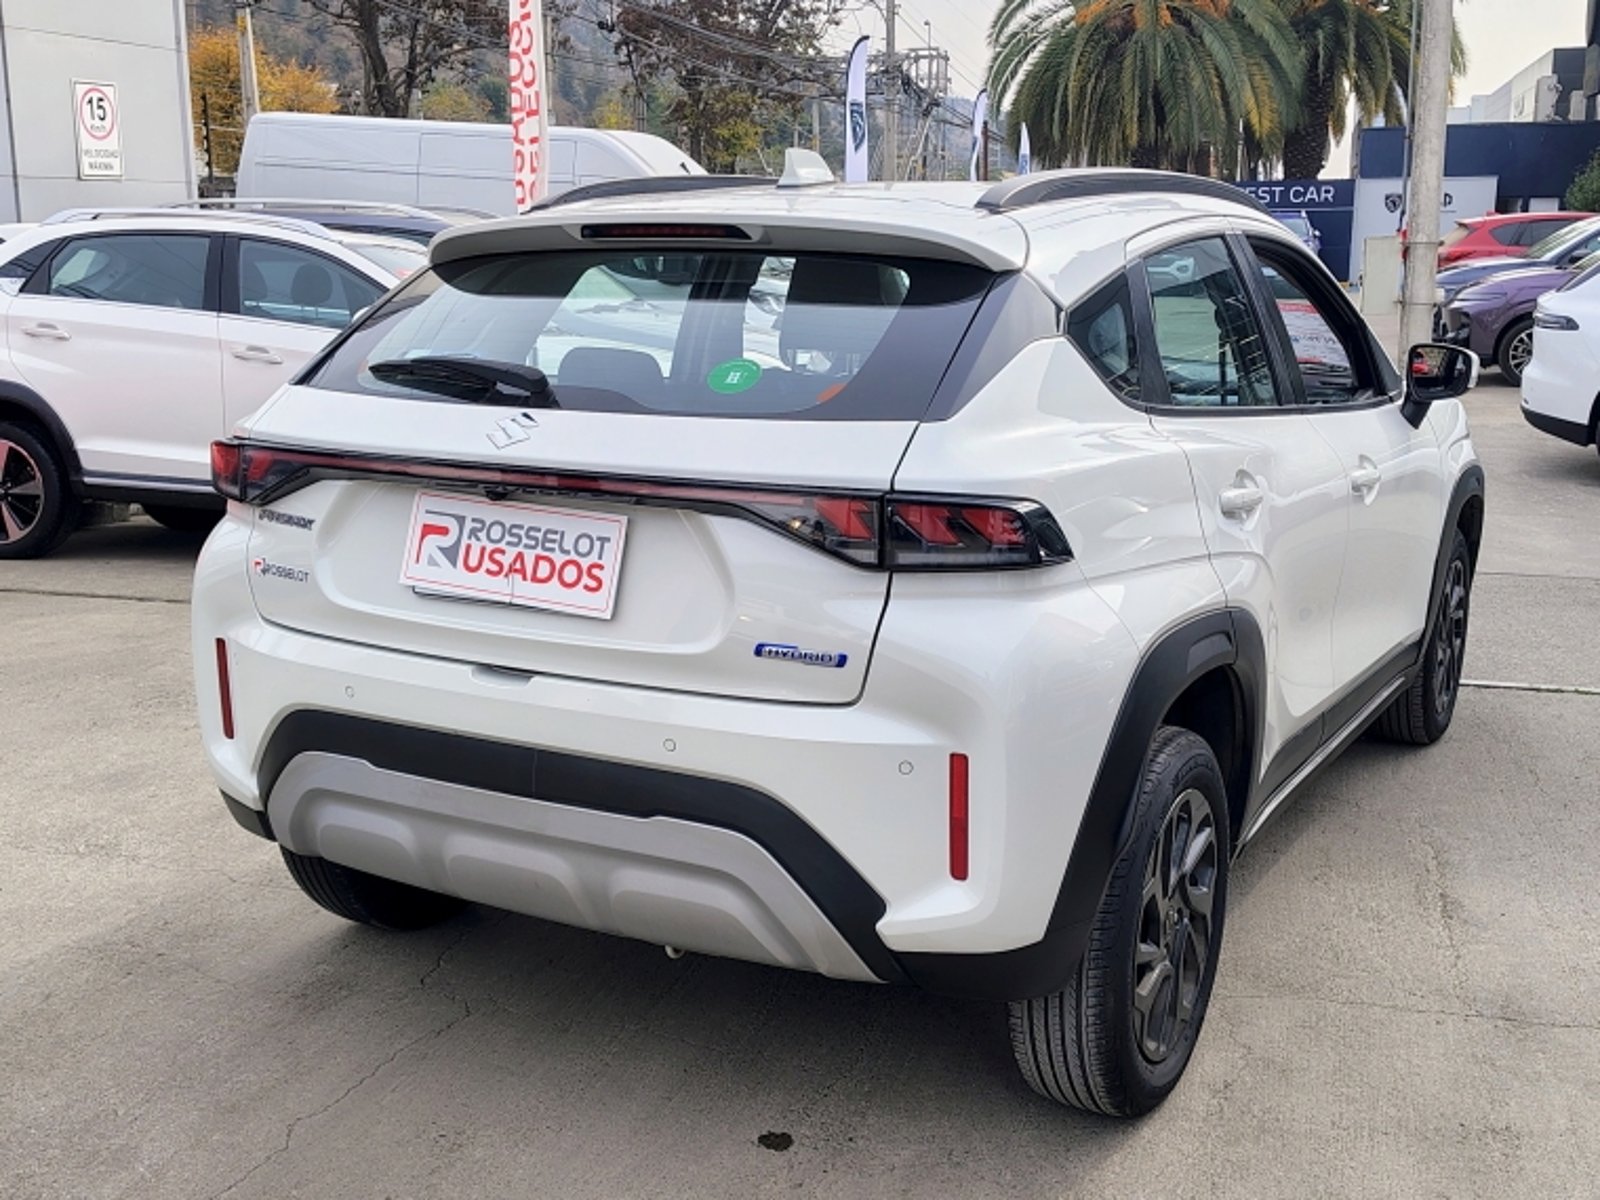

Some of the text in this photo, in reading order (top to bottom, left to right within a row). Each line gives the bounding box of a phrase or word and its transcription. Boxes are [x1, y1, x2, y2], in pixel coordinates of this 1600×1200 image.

[86, 96, 107, 121] 15
[1289, 185, 1335, 204] CAR
[466, 517, 611, 561] ROSSELOT
[462, 543, 606, 594] USADOS
